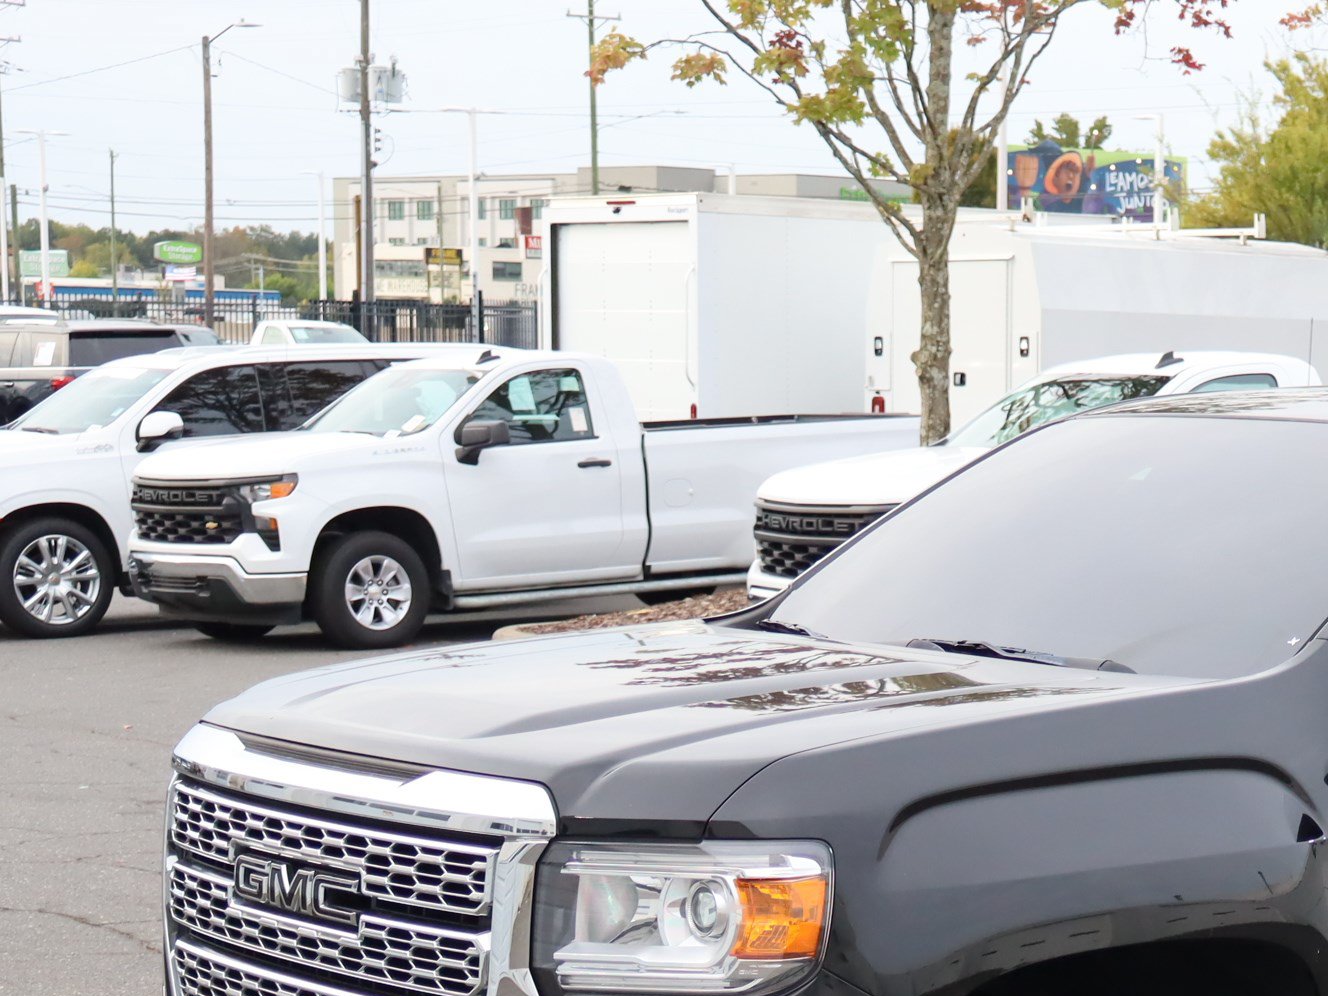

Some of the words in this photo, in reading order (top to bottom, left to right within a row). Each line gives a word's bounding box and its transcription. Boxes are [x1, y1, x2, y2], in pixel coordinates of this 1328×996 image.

[132, 488, 221, 502] CHEVROLET
[756, 512, 864, 532] CHEVROLET
[234, 854, 359, 926] GMC
